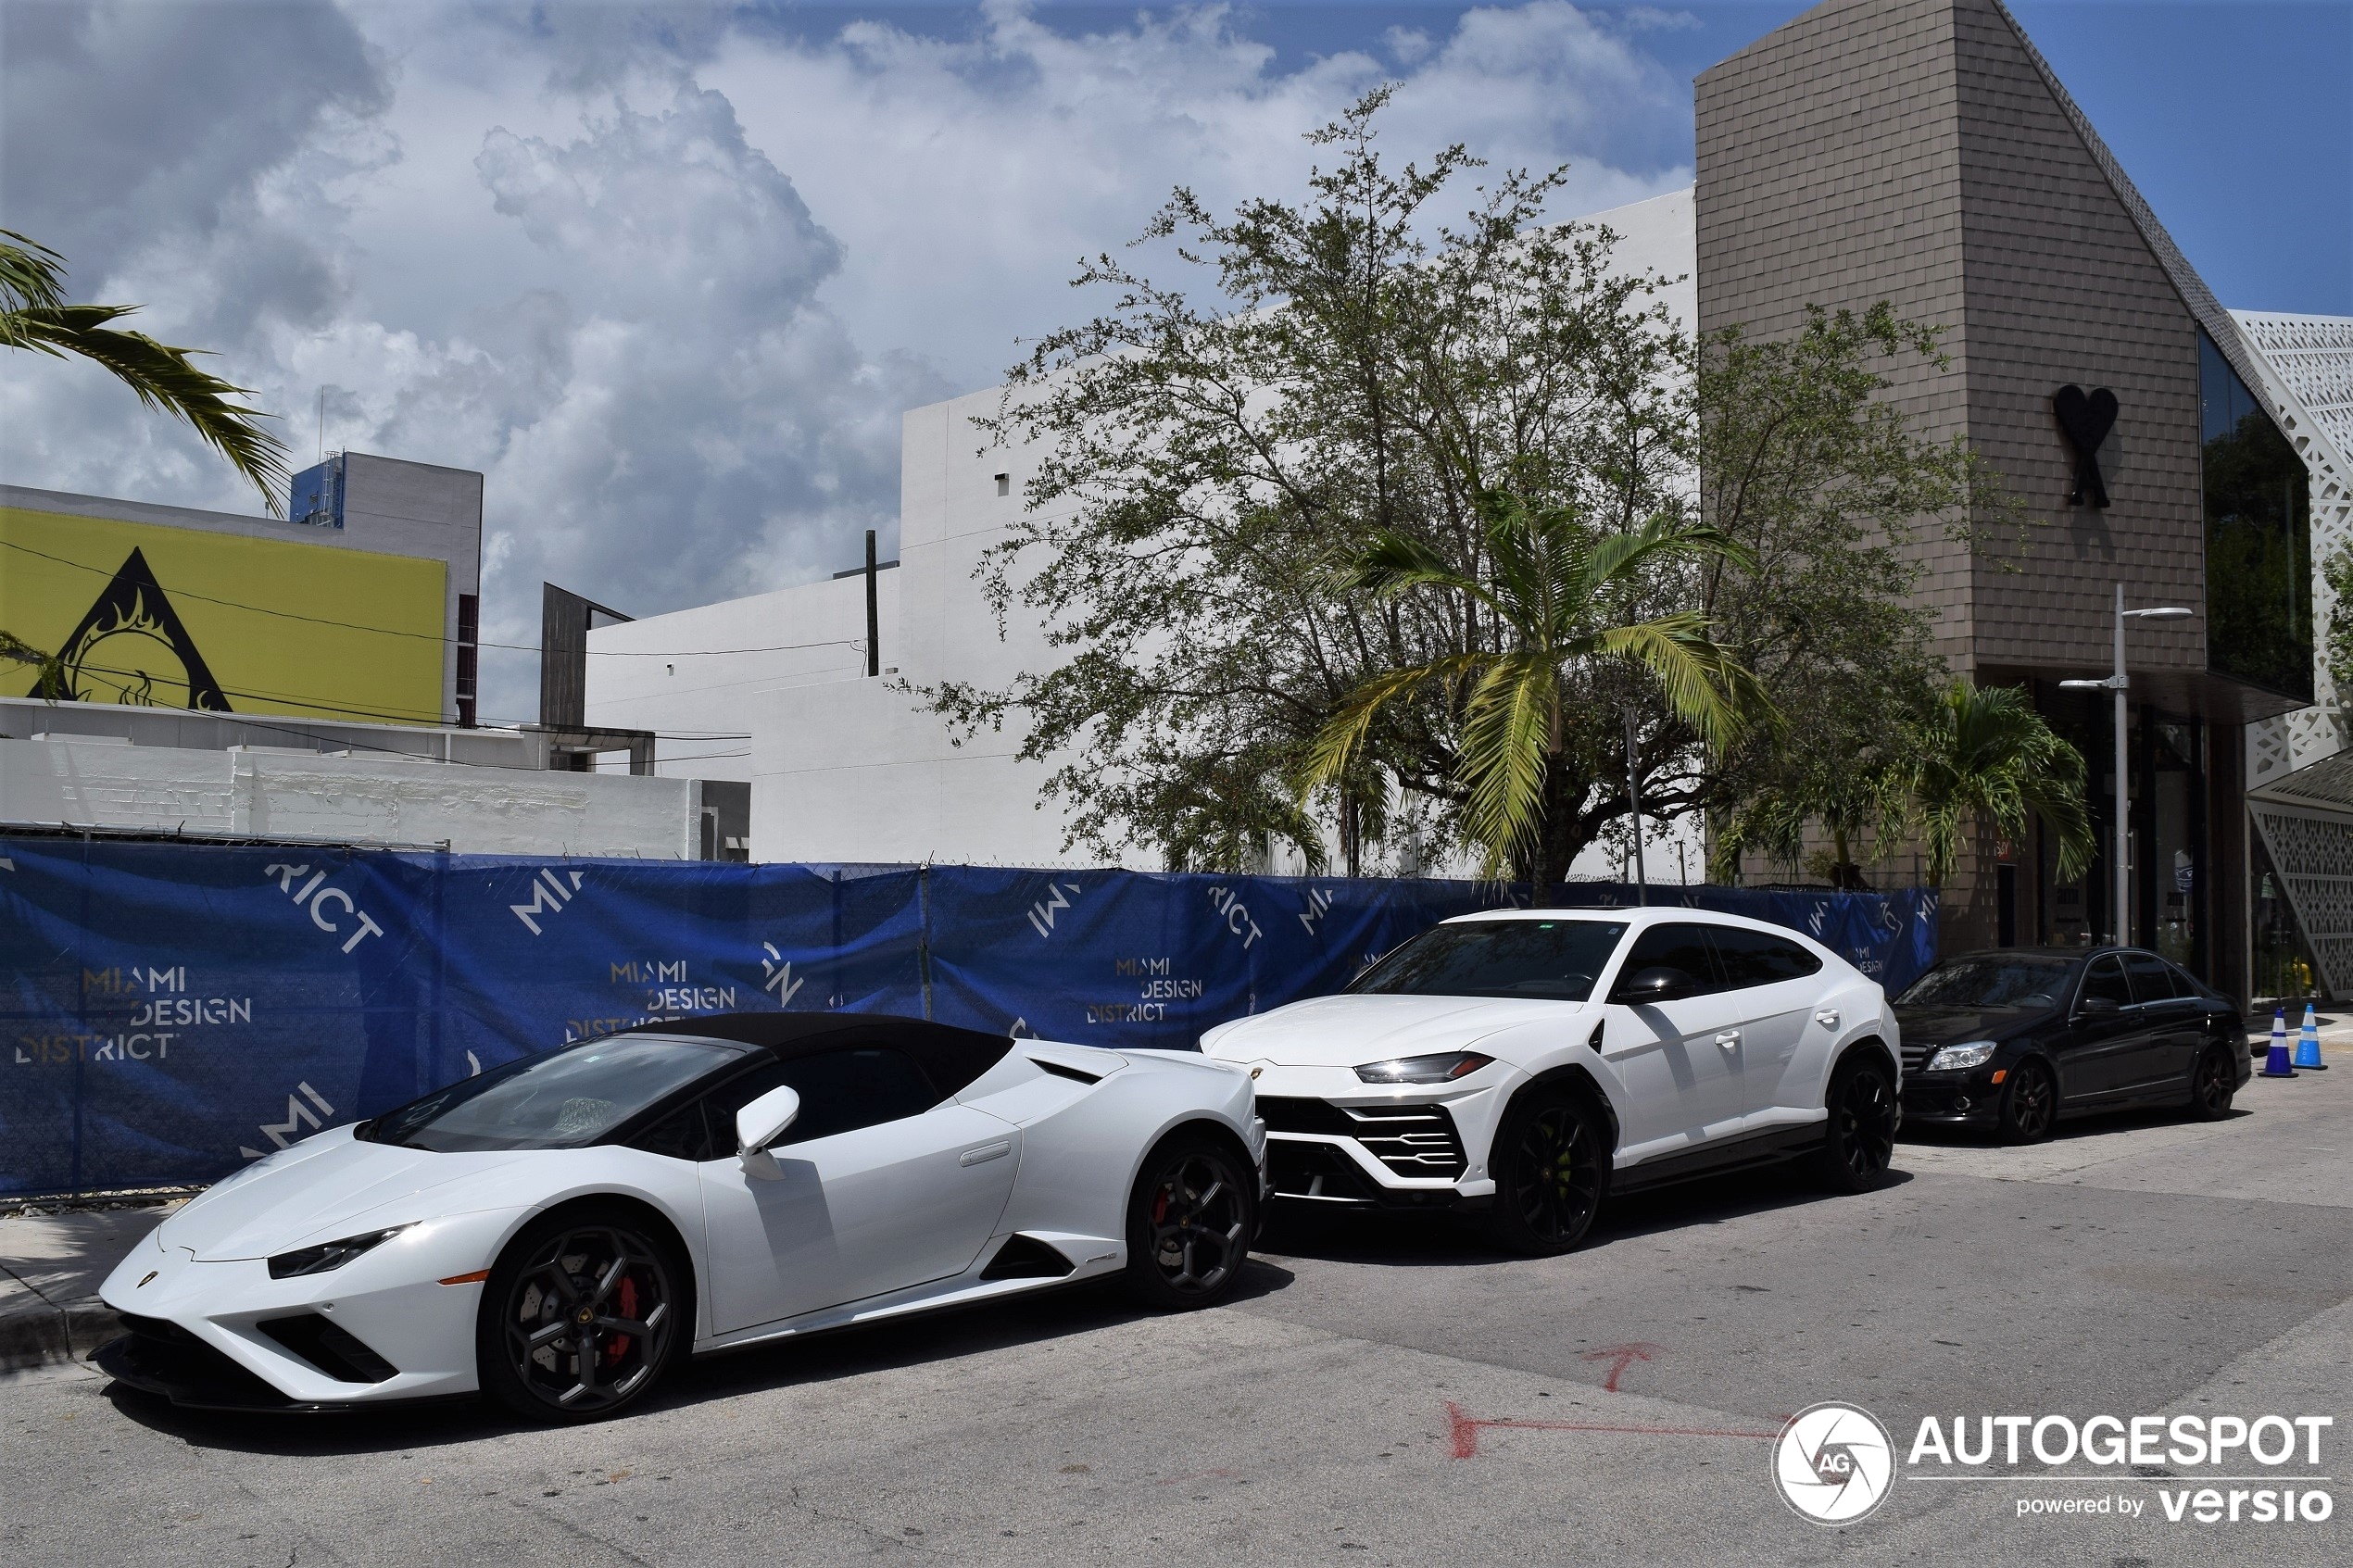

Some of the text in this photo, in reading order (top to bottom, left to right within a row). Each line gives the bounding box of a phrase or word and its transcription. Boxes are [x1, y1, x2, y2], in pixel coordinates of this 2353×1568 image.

[610, 960, 686, 984] MIAMI
[1116, 958, 1170, 976] MIAMI
[82, 966, 185, 993] MIAMI
[1141, 980, 1202, 998] DESIGN
[648, 987, 736, 1010] DESIGN
[130, 997, 251, 1026] DESIGN
[1087, 1003, 1165, 1023] DISTRICT
[16, 1033, 177, 1063] DISTRICT
